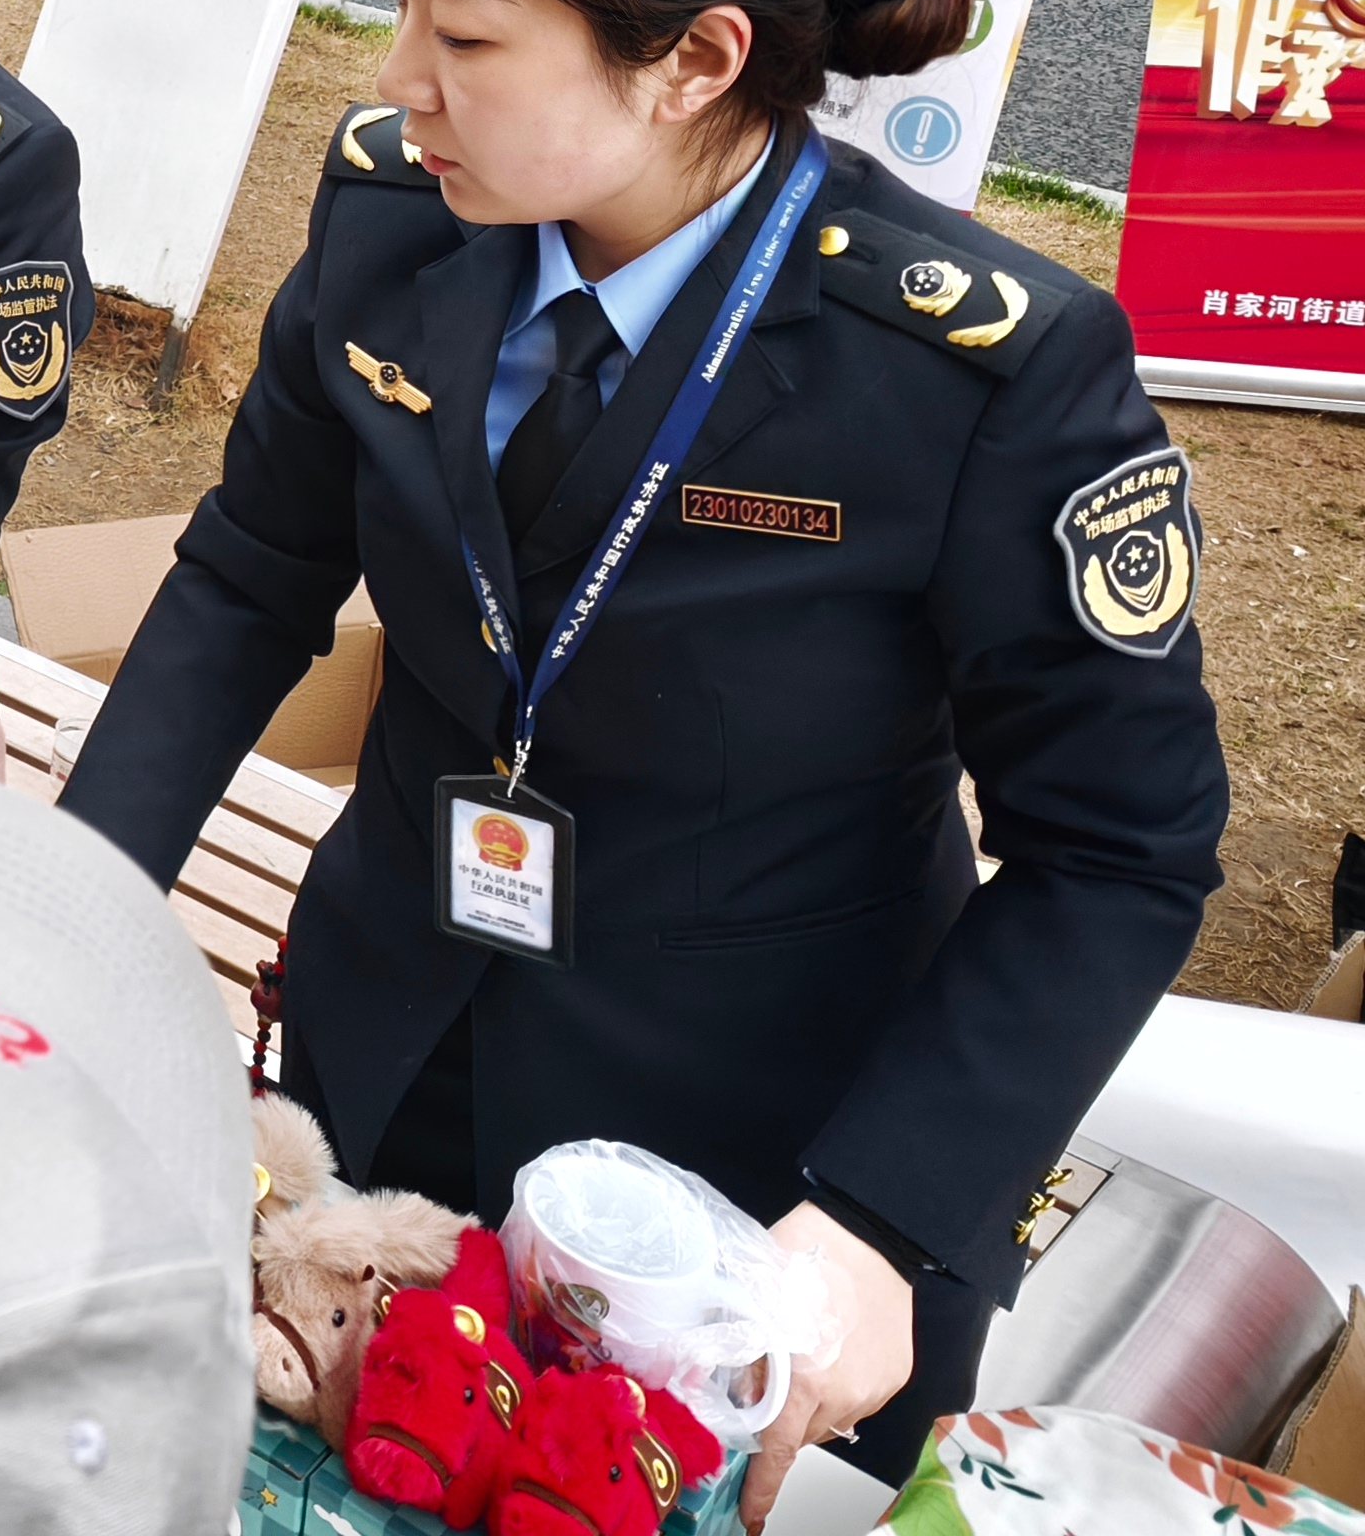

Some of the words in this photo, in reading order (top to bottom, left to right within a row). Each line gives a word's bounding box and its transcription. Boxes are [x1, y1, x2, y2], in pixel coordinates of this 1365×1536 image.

[1201, 289, 1365, 326] 肖家河街道
[700, 297, 750, 383] Administrative
[688, 492, 830, 534] 23010230134
[1072, 465, 1180, 528] 中华人民共和国
[1085, 488, 1171, 541] 市场监管执法
[551, 460, 670, 660] 中华人民共和国行政执法证
[457, 863, 544, 897] 中华人民共和国
[471, 880, 531, 906] 行政执法证
